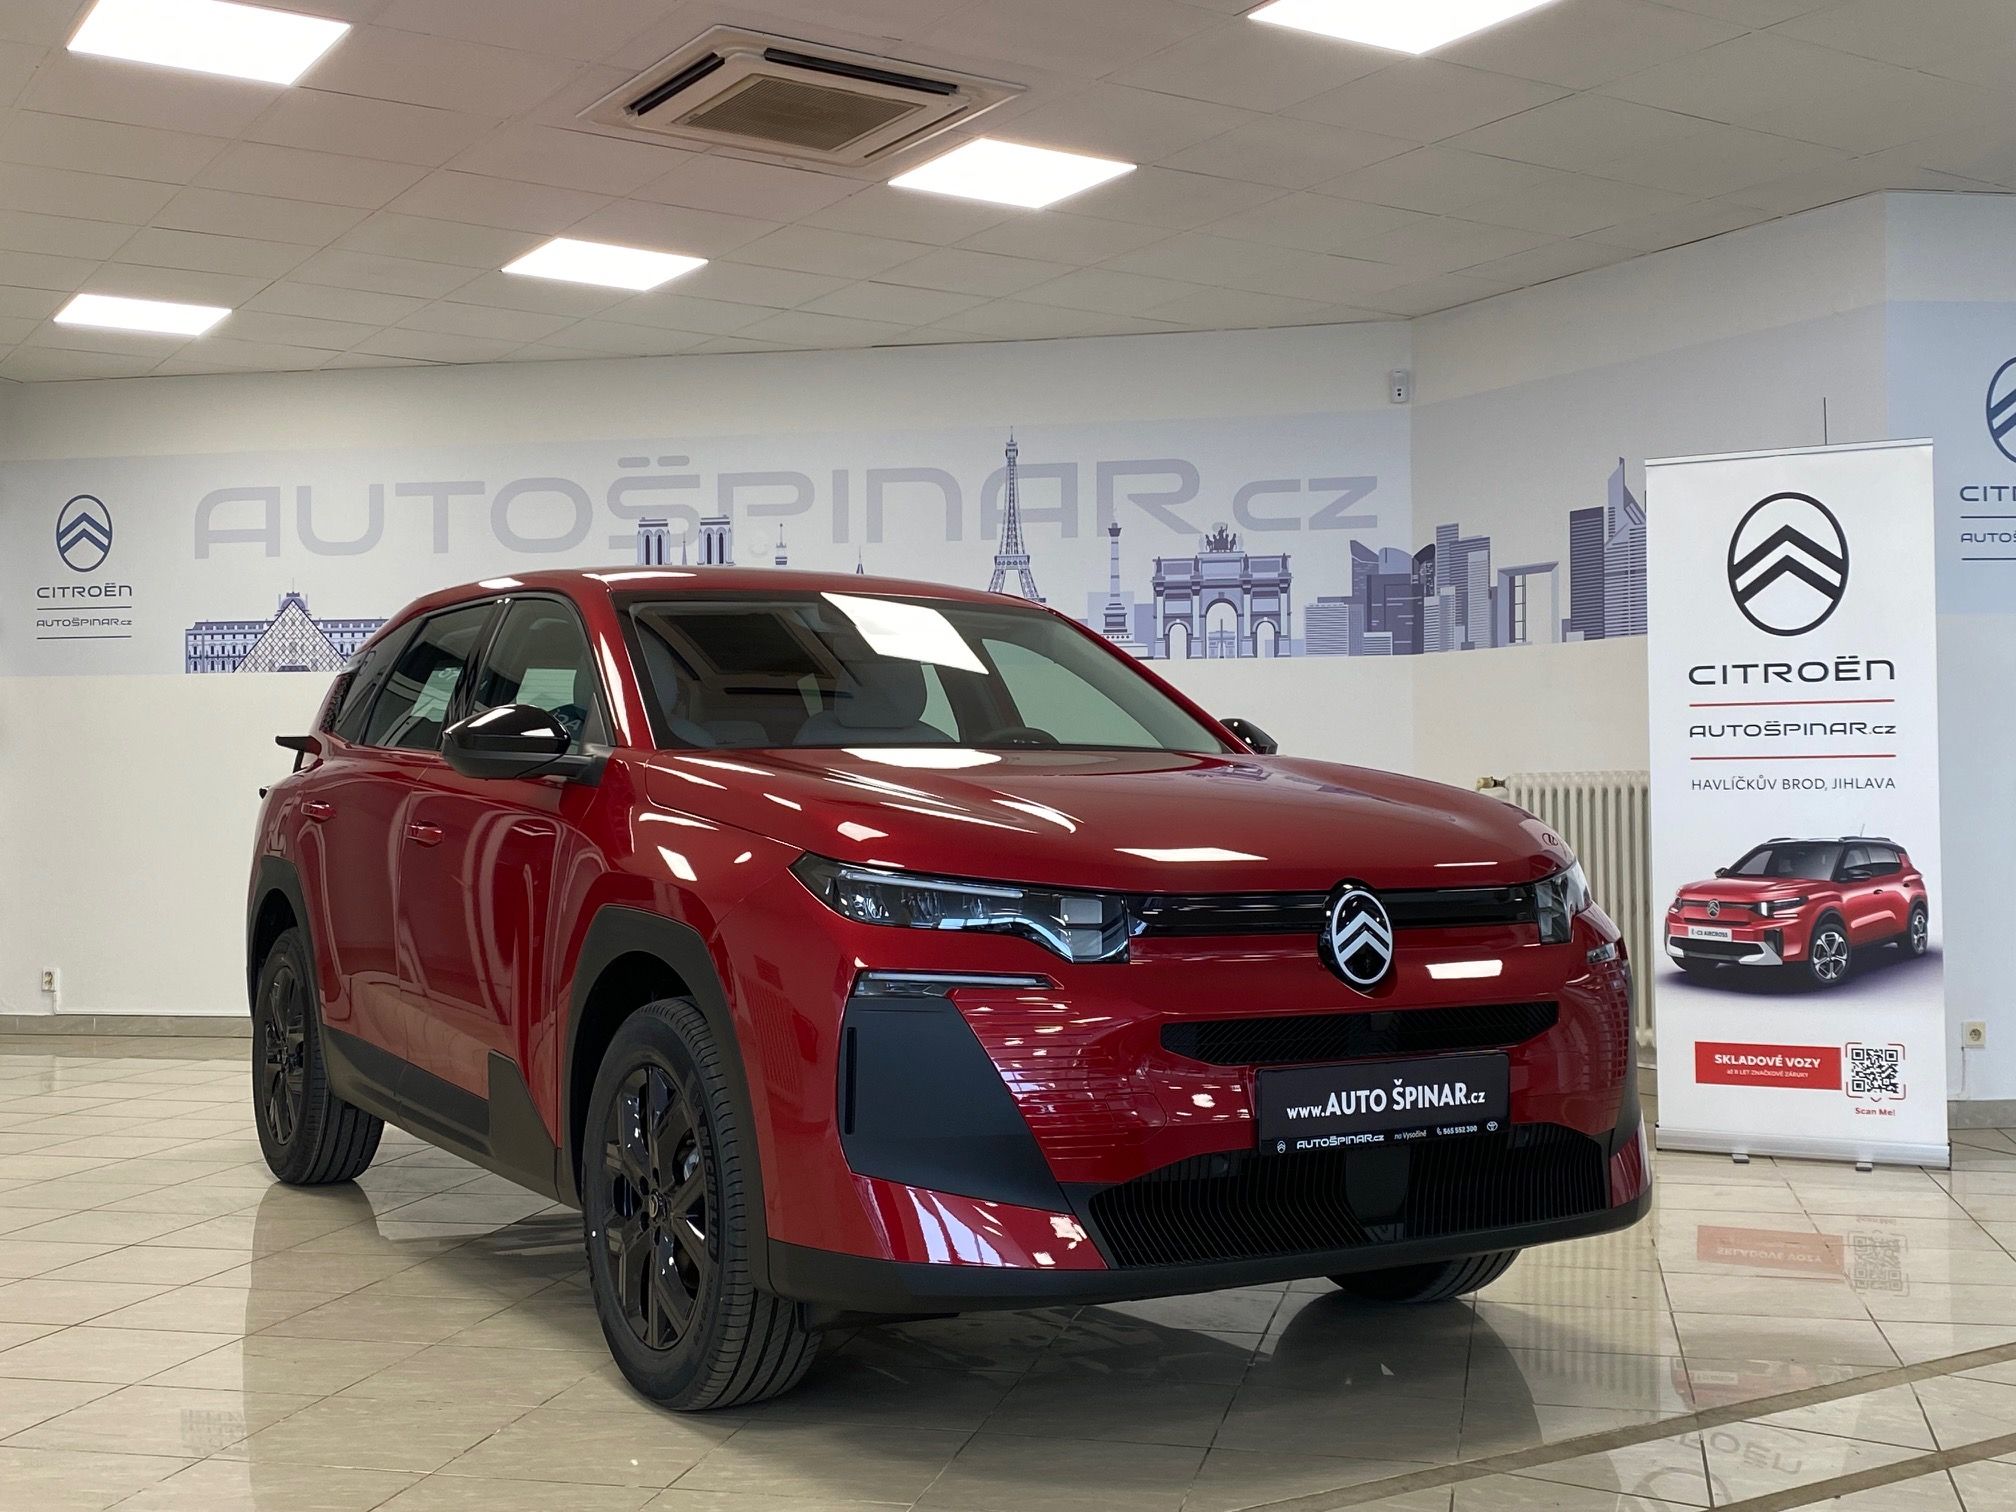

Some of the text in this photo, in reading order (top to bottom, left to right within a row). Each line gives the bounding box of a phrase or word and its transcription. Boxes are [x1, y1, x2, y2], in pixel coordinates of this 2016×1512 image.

[1960, 485, 2016, 502] CIT
[1961, 530, 2016, 543] AUTO
[1689, 720, 1897, 738] AUTOŠPINAR.cz
[1691, 774, 1896, 792] HAVLÍČKŮV BROD, JIHLAVA
[1714, 1054, 1821, 1068] SKLADOVÉ VOZY
[1286, 1079, 1485, 1120] www.AUTO ŠPINAR.cz
[1855, 1107, 1896, 1117] Scan Me!
